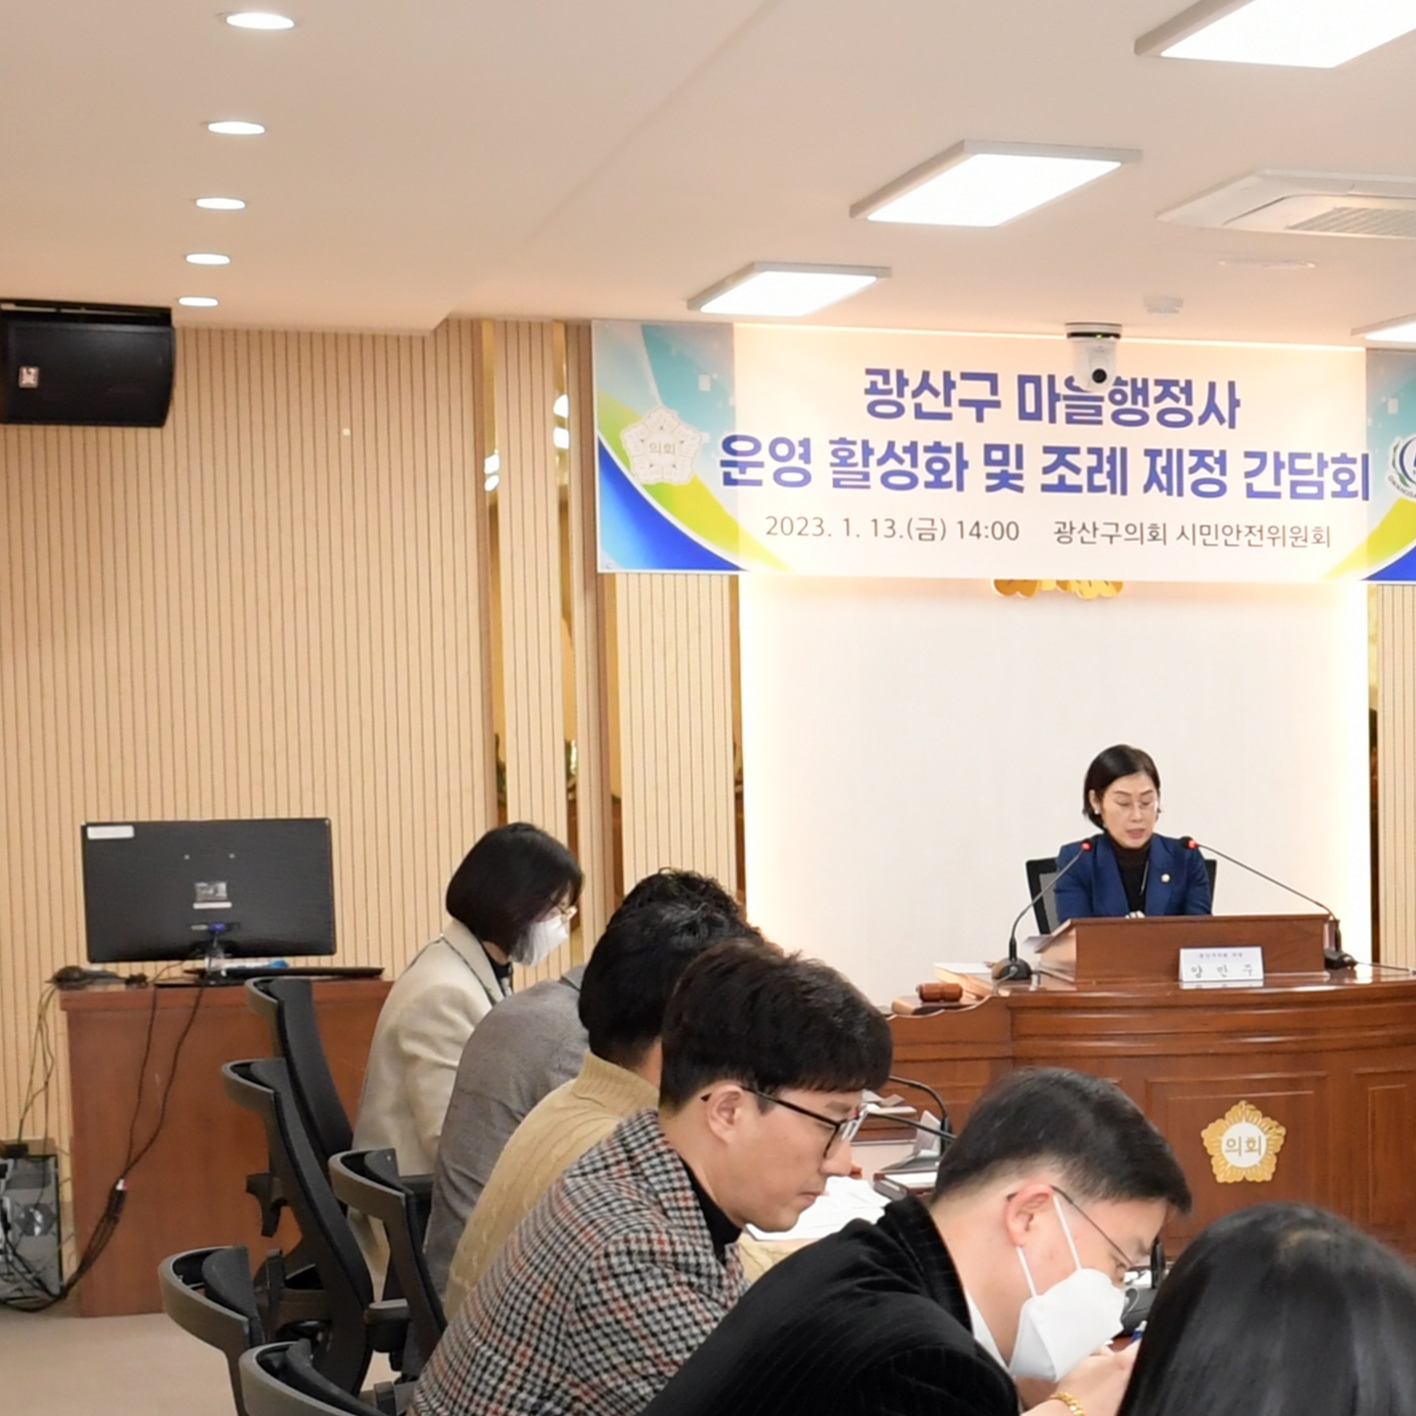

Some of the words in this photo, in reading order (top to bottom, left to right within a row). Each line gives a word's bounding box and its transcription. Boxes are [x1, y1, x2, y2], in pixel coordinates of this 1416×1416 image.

[863, 367, 1002, 424] 광산구
[1016, 373, 1241, 430] 마을행정사
[719, 434, 813, 488] 운영
[828, 437, 969, 493] 활성화
[982, 442, 1025, 494] 및
[1040, 445, 1128, 497] 조례
[1142, 448, 1228, 499] 제정
[1243, 450, 1370, 502] 간담회
[765, 515, 833, 538] 2023.
[957, 519, 1021, 542] 14:00
[1053, 520, 1168, 546] 광산구의회
[1176, 522, 1331, 549] 시민안전위원회
[1224, 1134, 1262, 1158] 의회
